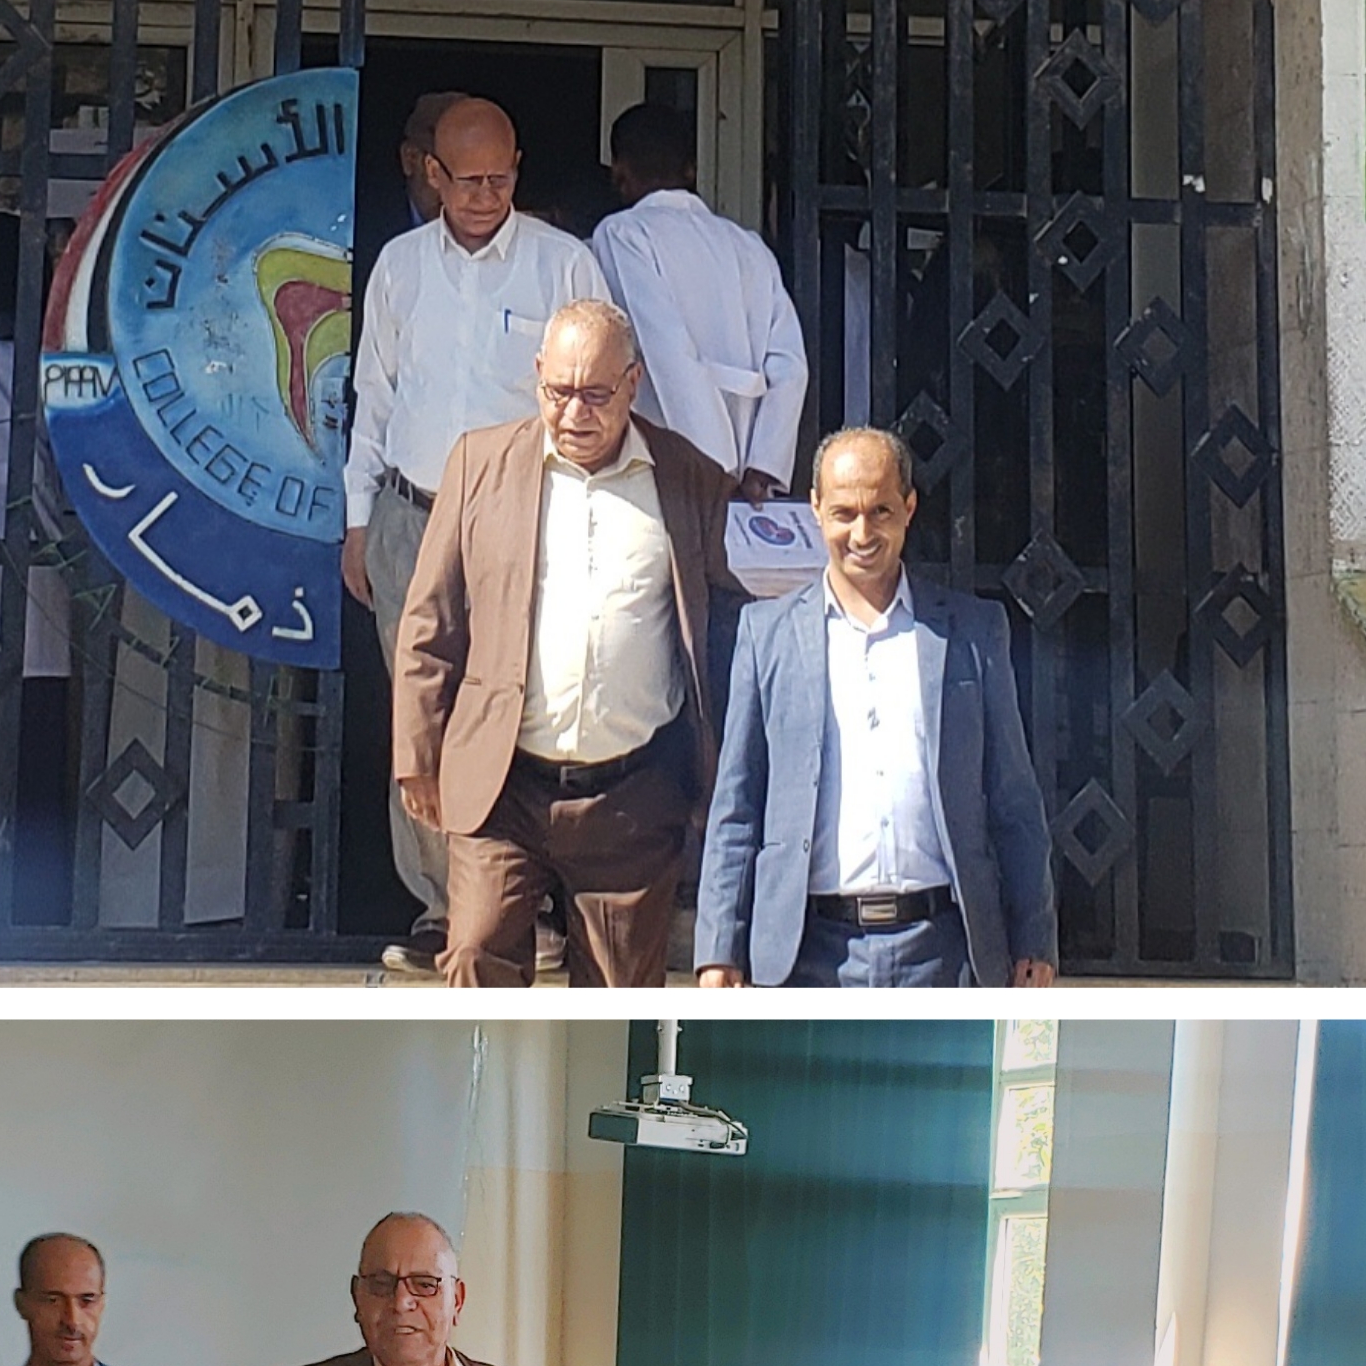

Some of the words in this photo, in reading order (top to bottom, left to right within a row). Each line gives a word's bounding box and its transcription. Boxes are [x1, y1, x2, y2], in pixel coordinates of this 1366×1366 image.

[140, 98, 347, 311] الأسنان
[132, 348, 271, 499] COLLEGE
[275, 486, 334, 523] OF
[83, 462, 314, 642] ذمار
